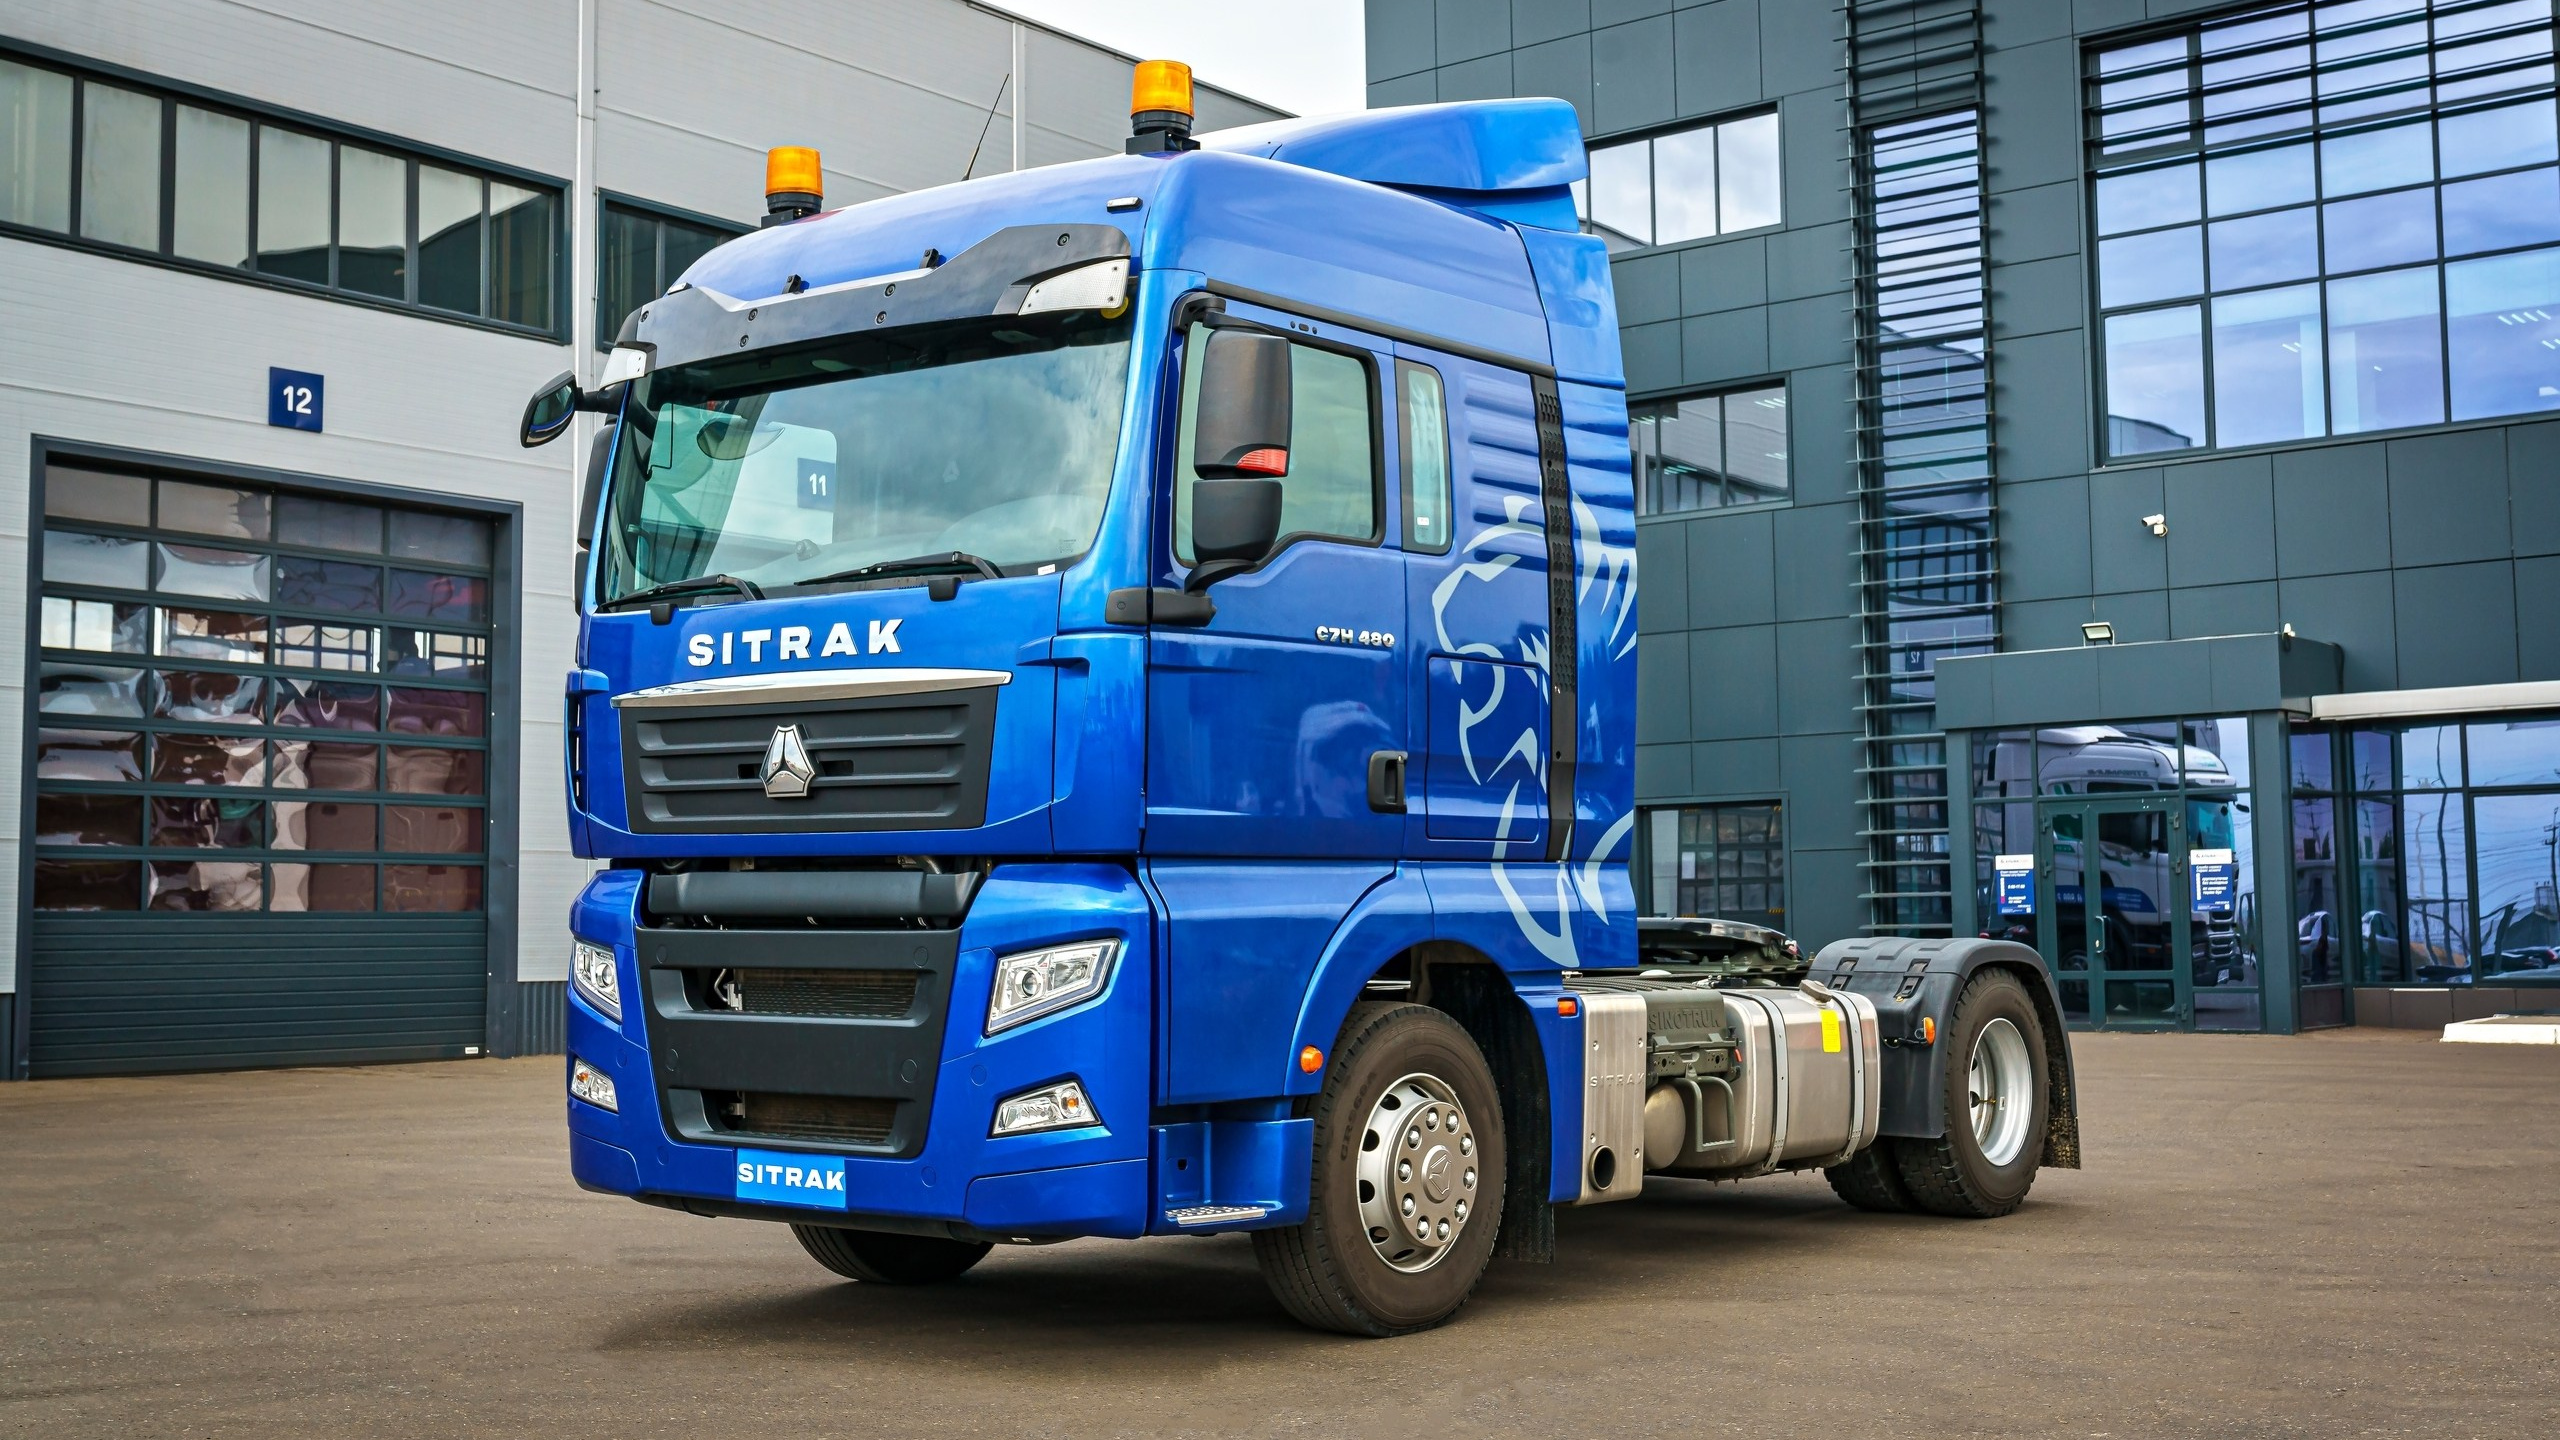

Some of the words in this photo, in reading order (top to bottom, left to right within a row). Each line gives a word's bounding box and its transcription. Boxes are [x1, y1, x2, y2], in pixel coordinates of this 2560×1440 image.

[283, 385, 313, 415] 12
[809, 473, 827, 497] 11
[687, 618, 904, 667] SITRAK
[1315, 625, 1354, 643] C7H
[1358, 630, 1395, 648] 480
[1647, 1008, 1721, 1031] SINOTRUK
[1589, 1071, 1646, 1088] SITRAK
[737, 1162, 845, 1192] SITRAK
